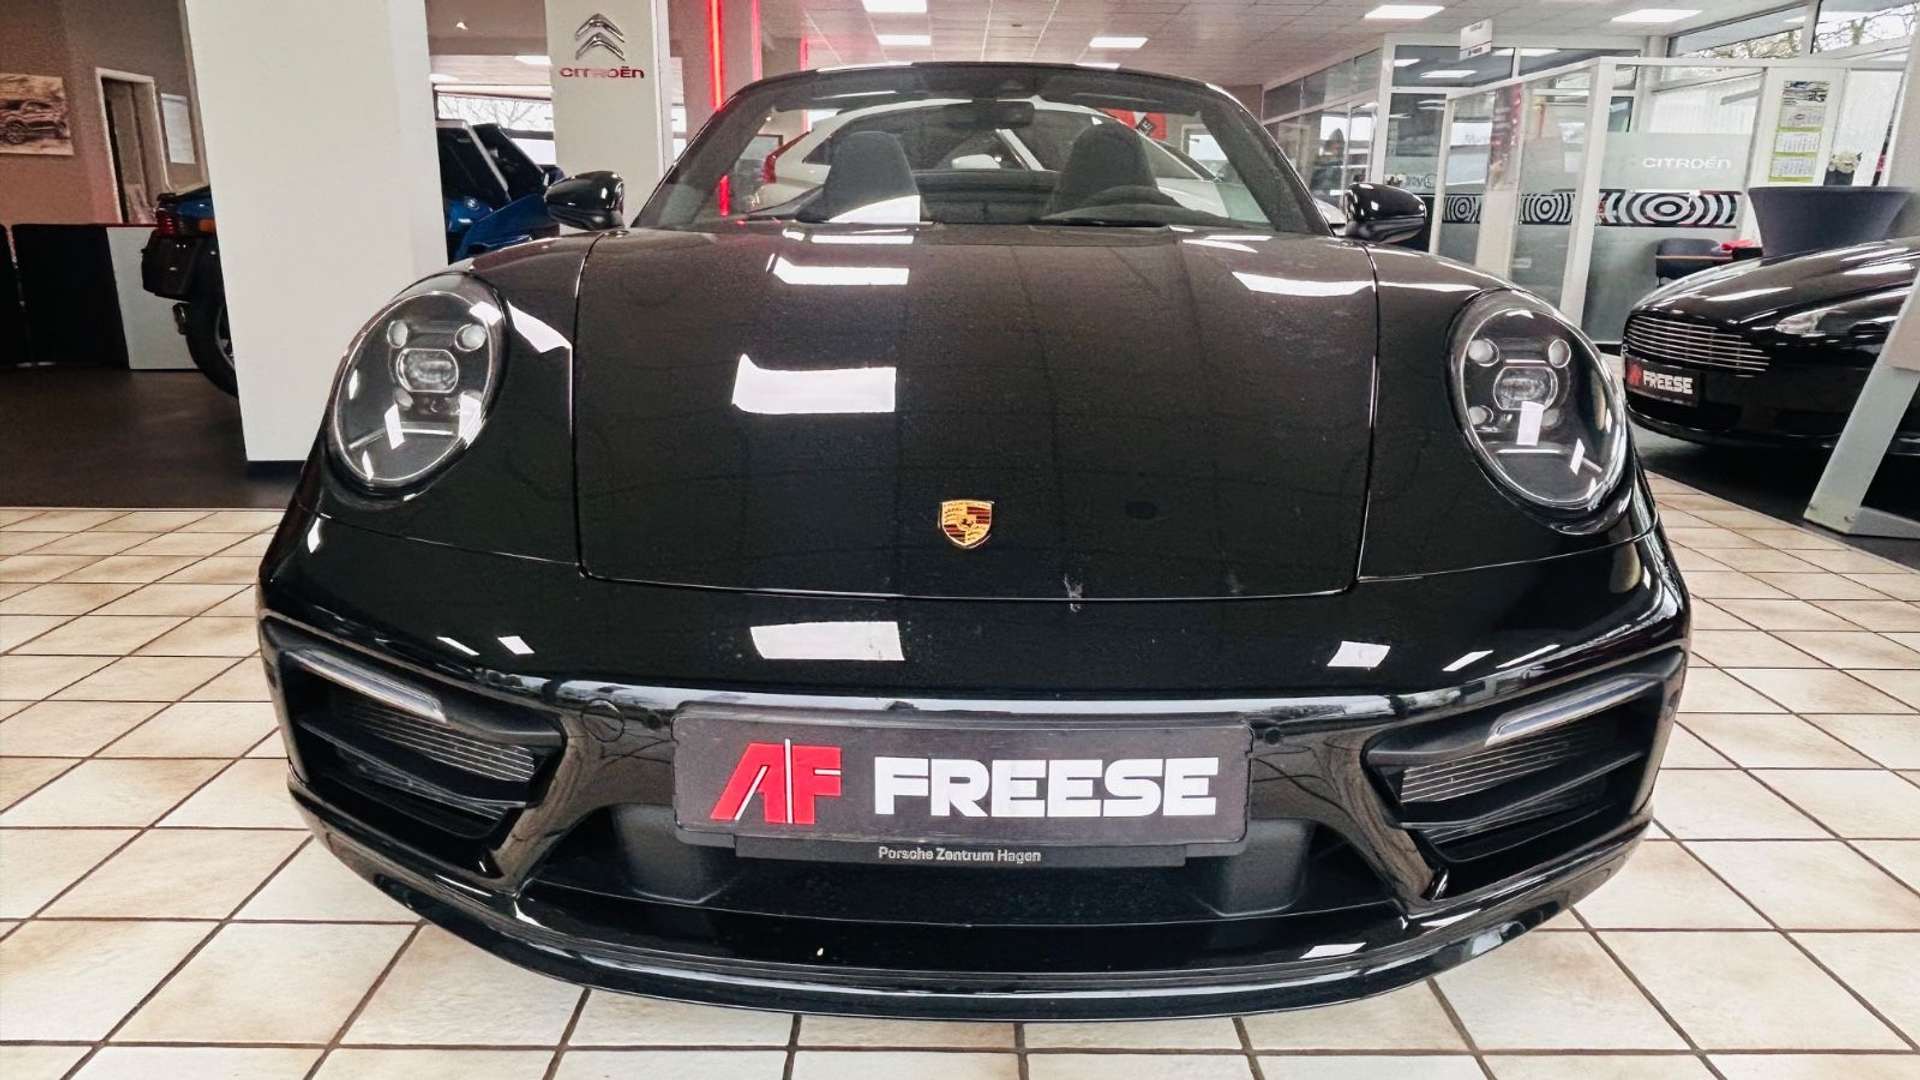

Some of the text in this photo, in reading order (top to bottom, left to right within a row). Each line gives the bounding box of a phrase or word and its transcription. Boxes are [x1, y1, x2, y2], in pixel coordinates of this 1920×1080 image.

[1643, 369, 1694, 395] FREESE
[710, 739, 1219, 825] AF FREESE
[878, 846, 1041, 864] Porsche Zentrum Hagen
